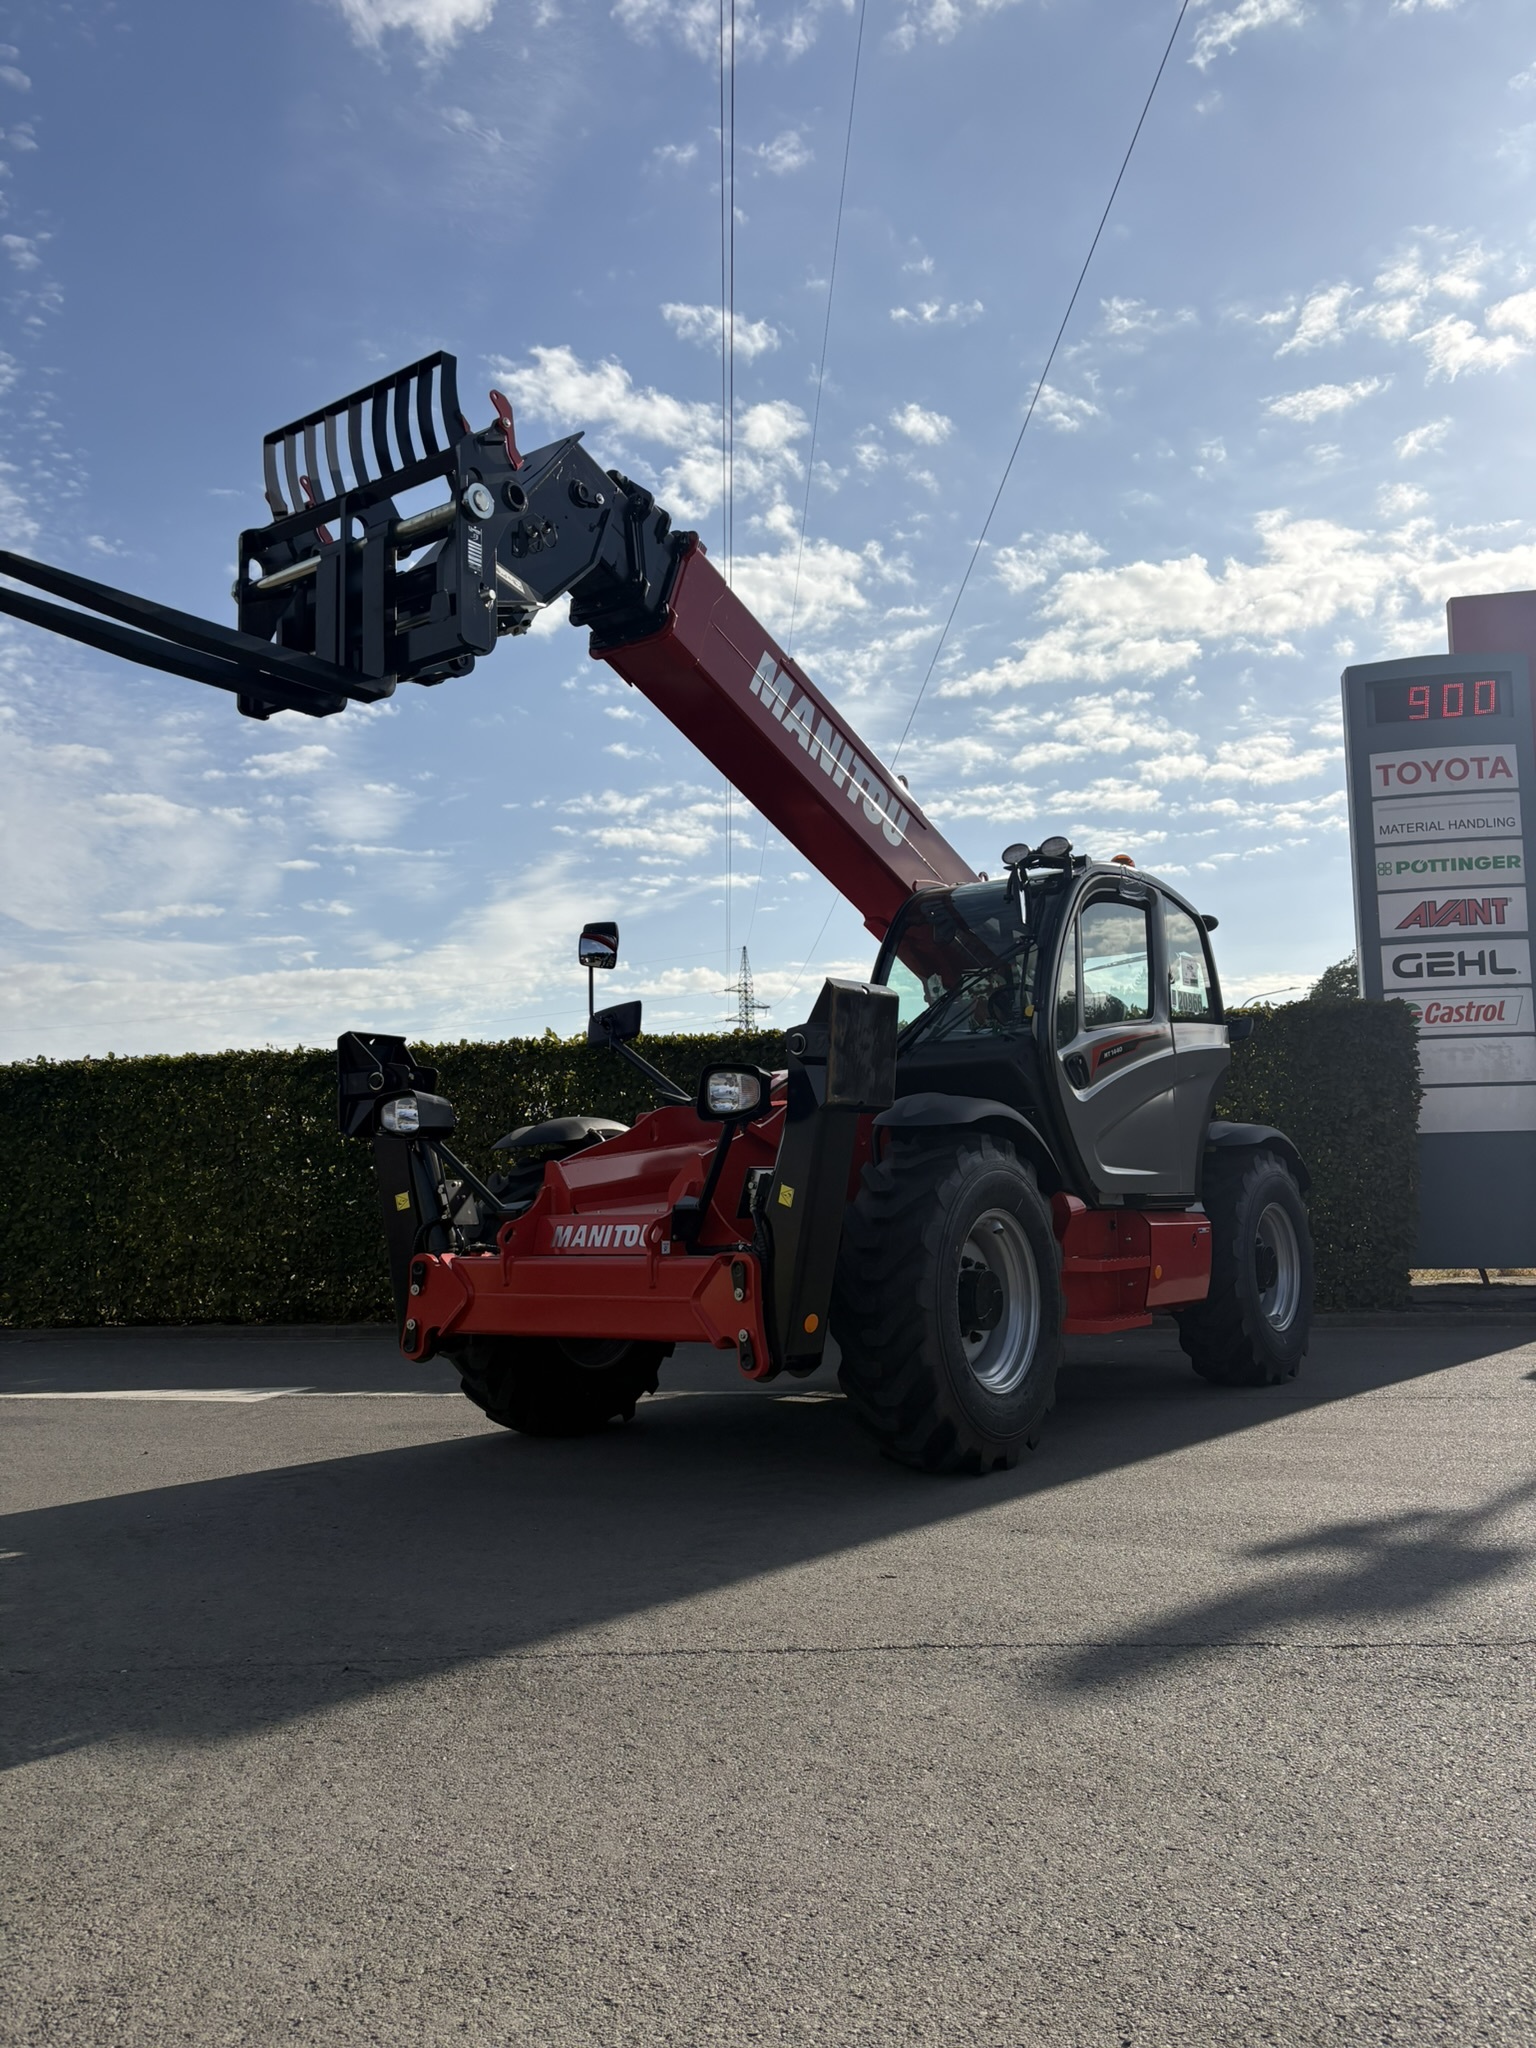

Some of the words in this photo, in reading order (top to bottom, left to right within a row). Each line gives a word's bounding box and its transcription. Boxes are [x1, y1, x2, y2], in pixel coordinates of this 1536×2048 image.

[749, 649, 910, 847] MANITOU
[1375, 756, 1513, 786] TOYOTA
[1379, 821, 1445, 836] MATERIAL
[1448, 817, 1516, 830] HANDLING
[1396, 855, 1522, 875] PÖTTINGER
[1394, 897, 1509, 930] AVANT
[1392, 950, 1517, 979] GEHL
[1424, 1000, 1506, 1024] Castrol
